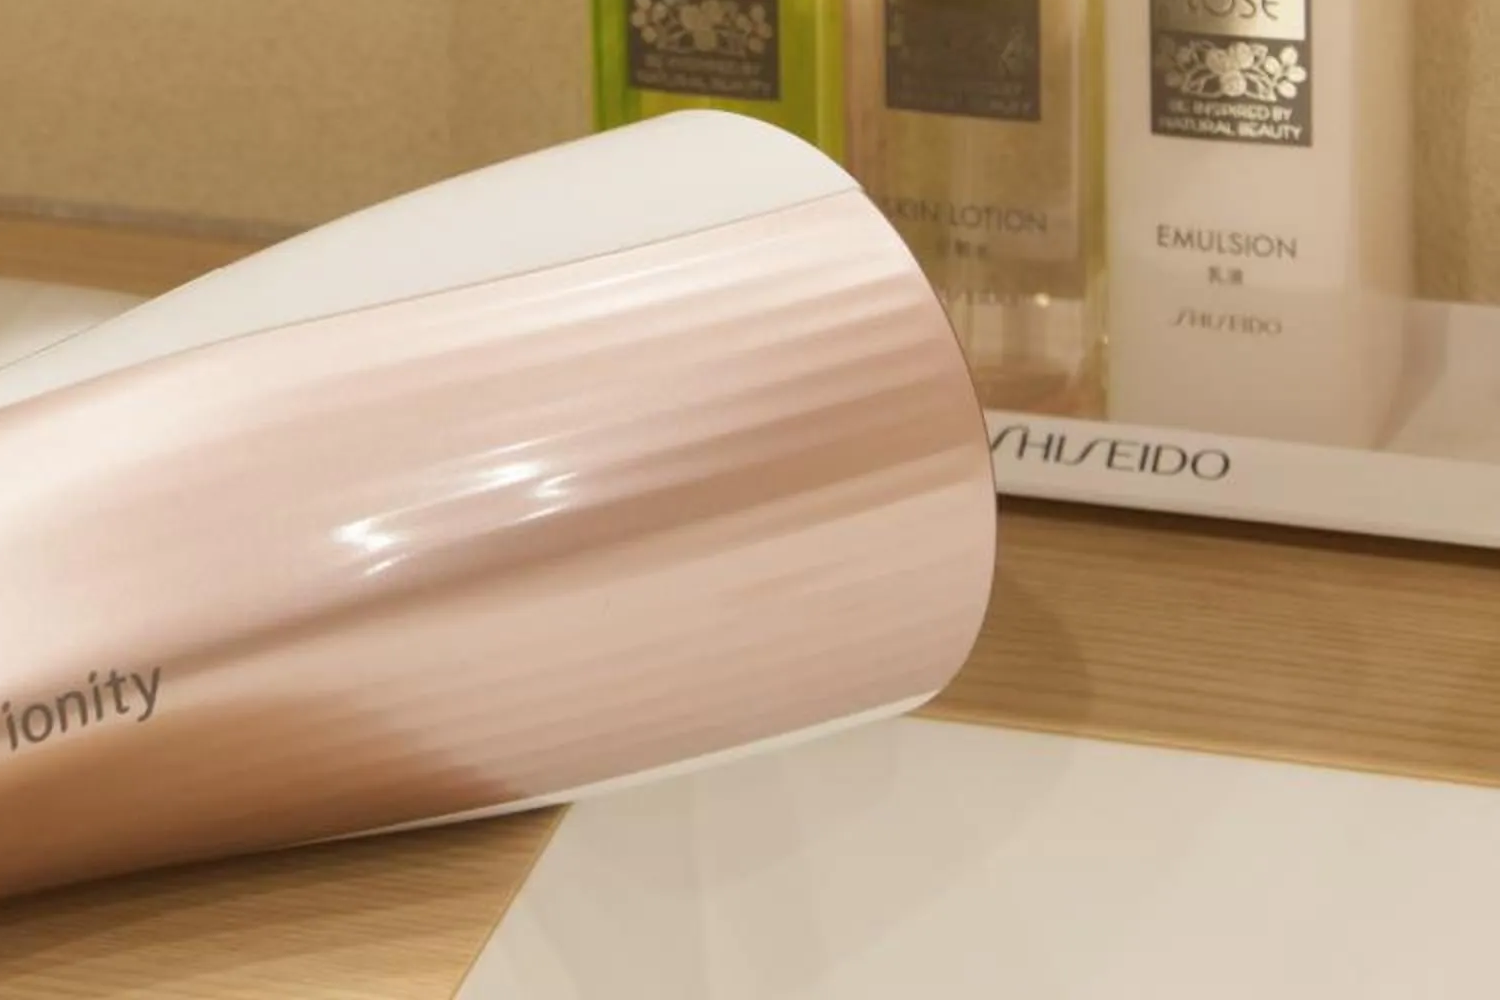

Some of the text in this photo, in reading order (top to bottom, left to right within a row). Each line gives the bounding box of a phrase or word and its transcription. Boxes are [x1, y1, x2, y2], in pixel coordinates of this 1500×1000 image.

[1237, 121, 1304, 142] BEAUTY
[950, 203, 1048, 233] LOTION
[1155, 222, 1298, 260] EMULSION
[1167, 305, 1284, 337] SHISEIDO
[990, 424, 1231, 482] SHISEIDO
[1, 666, 162, 752] ionity
